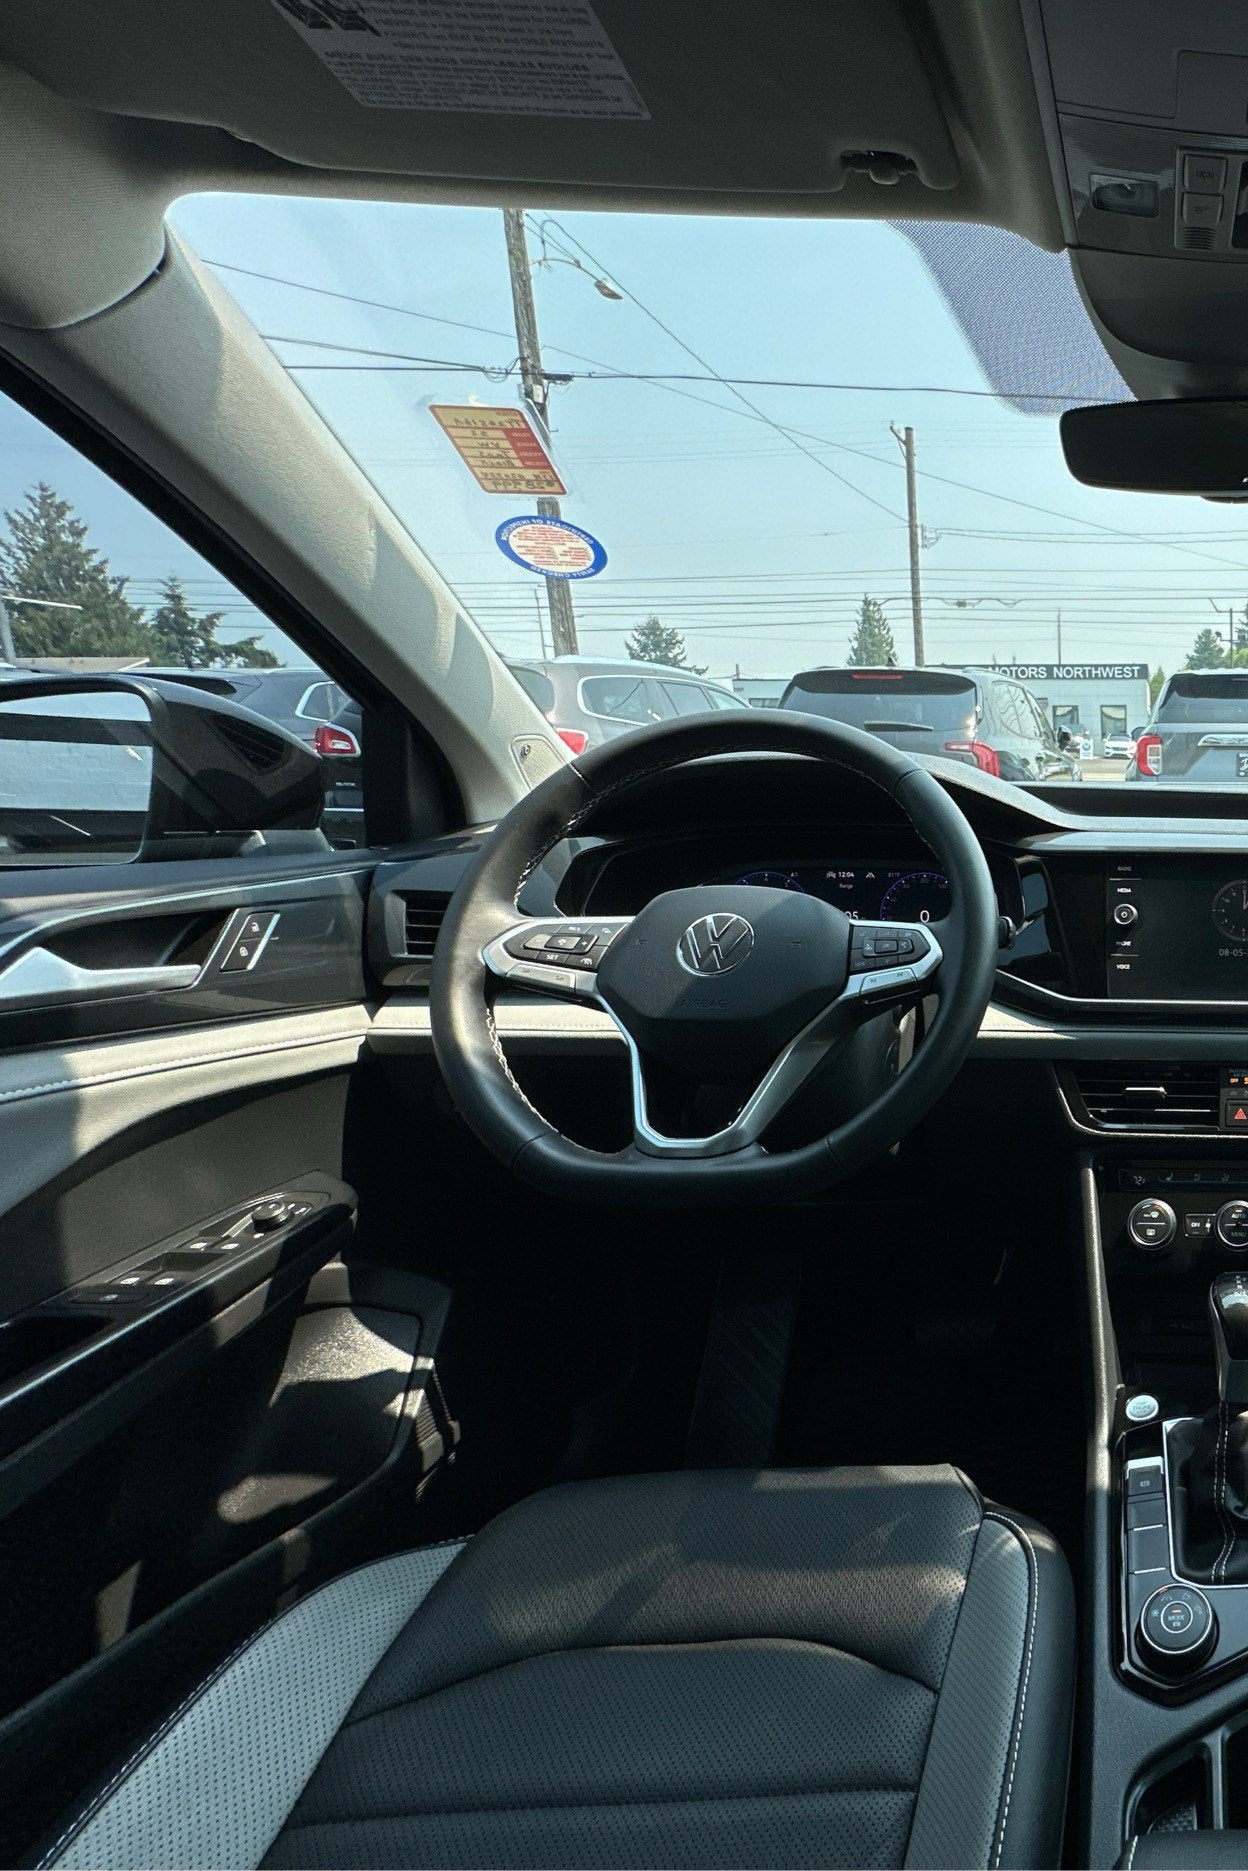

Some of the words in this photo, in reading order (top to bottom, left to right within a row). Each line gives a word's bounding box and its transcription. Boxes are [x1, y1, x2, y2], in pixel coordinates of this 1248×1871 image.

[1054, 666, 1140, 678] NORTHWEST
[920, 910, 930, 923] 0
[680, 998, 728, 1010] AIRBAG
